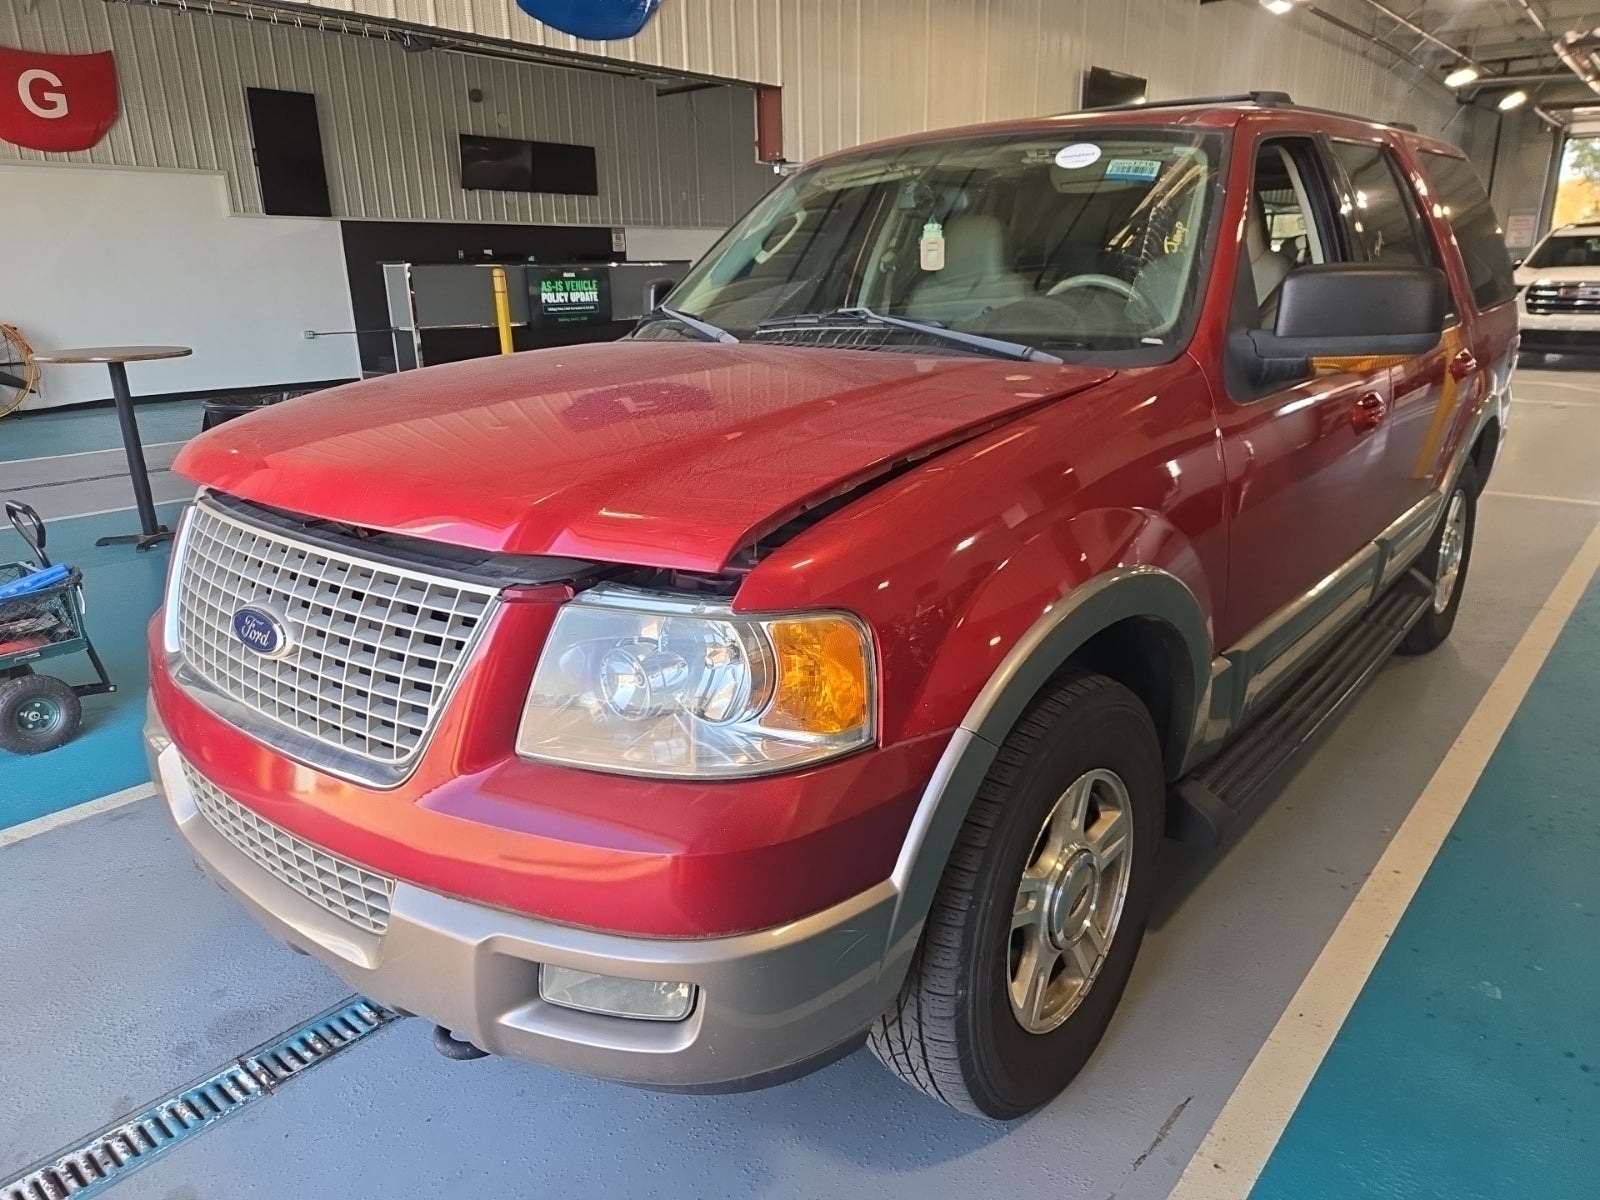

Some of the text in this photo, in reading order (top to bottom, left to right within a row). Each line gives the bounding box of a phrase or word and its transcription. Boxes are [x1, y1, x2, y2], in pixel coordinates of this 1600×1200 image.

[17, 69, 69, 119] G
[541, 280, 598, 292] AS-IS VEHICLE
[541, 291, 599, 304] POLICY UPDATE
[241, 614, 271, 647] Ford
